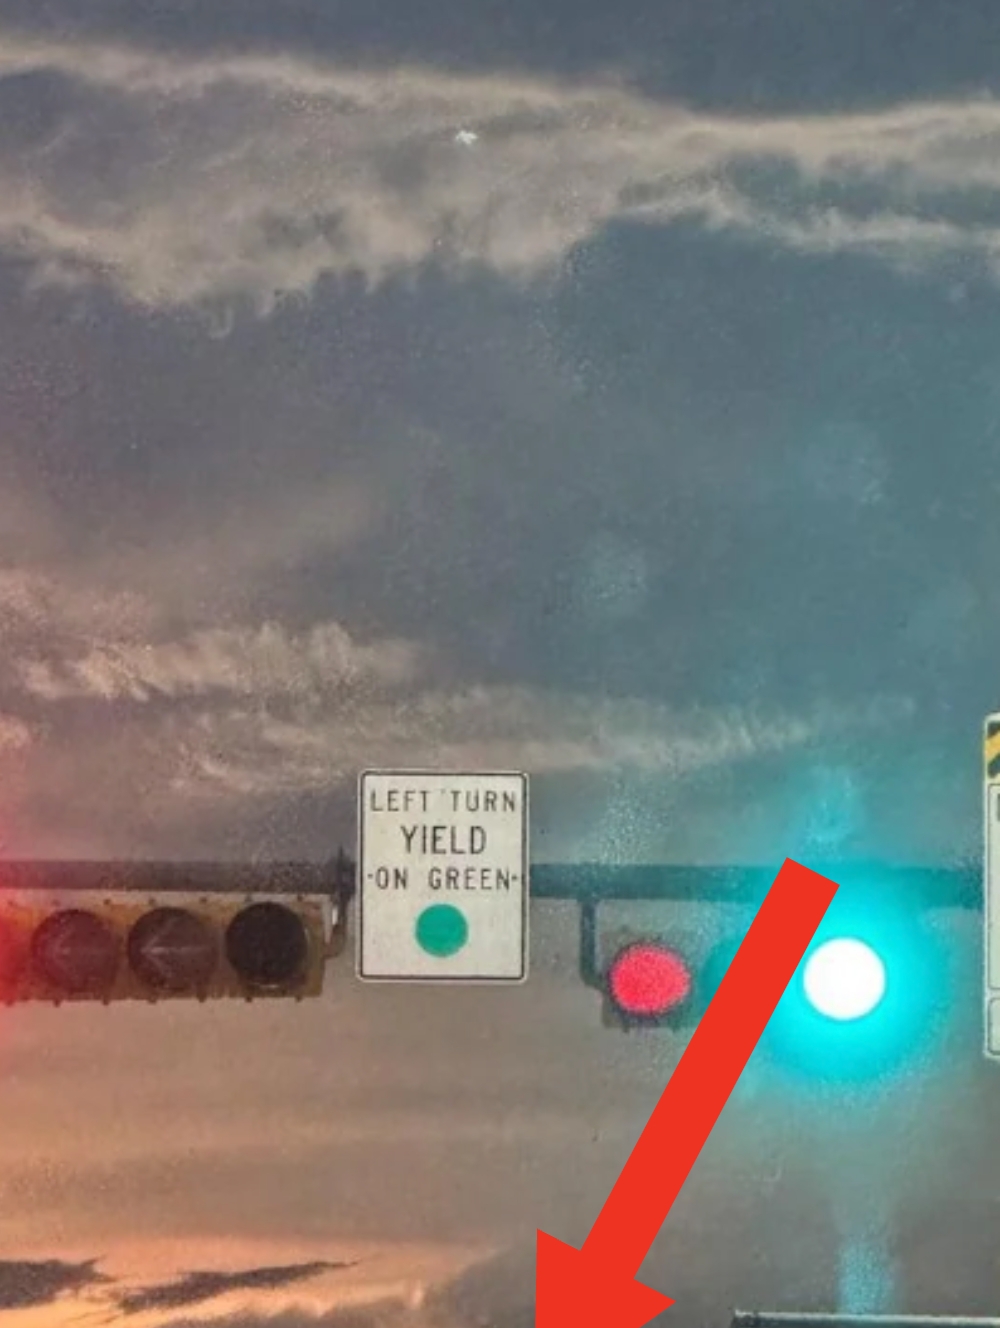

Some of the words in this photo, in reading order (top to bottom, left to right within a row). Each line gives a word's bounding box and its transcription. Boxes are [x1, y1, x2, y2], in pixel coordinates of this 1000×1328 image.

[370, 789, 430, 812] LEFT
[450, 789, 516, 812] TURN
[400, 825, 487, 855] YIELD
[375, 866, 408, 890] ON
[428, 867, 510, 891] GREEN
